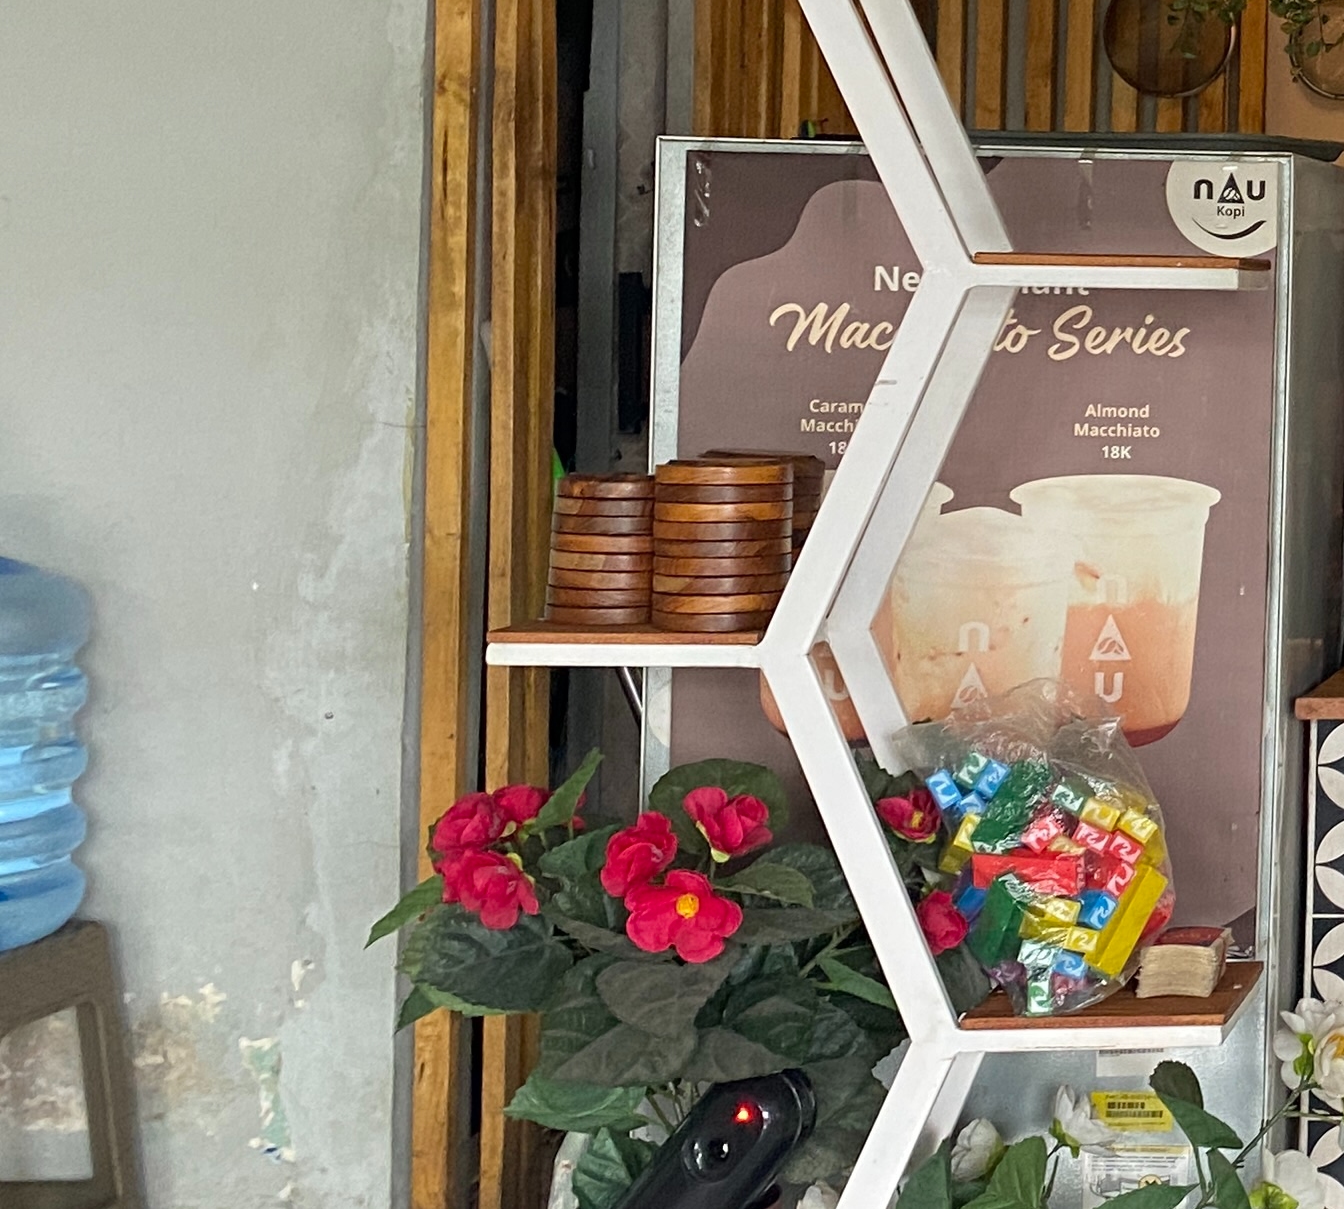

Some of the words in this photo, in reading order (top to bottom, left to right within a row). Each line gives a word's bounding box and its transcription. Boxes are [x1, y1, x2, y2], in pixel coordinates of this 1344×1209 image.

[1216, 205, 1246, 220] Kopi
[873, 264, 919, 292] Ne
[769, 302, 1041, 355] Macto
[1047, 305, 1188, 360] Series
[808, 399, 864, 414] Caram
[1085, 403, 1150, 419] Almond
[1074, 422, 1161, 438] Macchiato
[829, 441, 847, 456] 18
[1100, 444, 1132, 460] 18K
